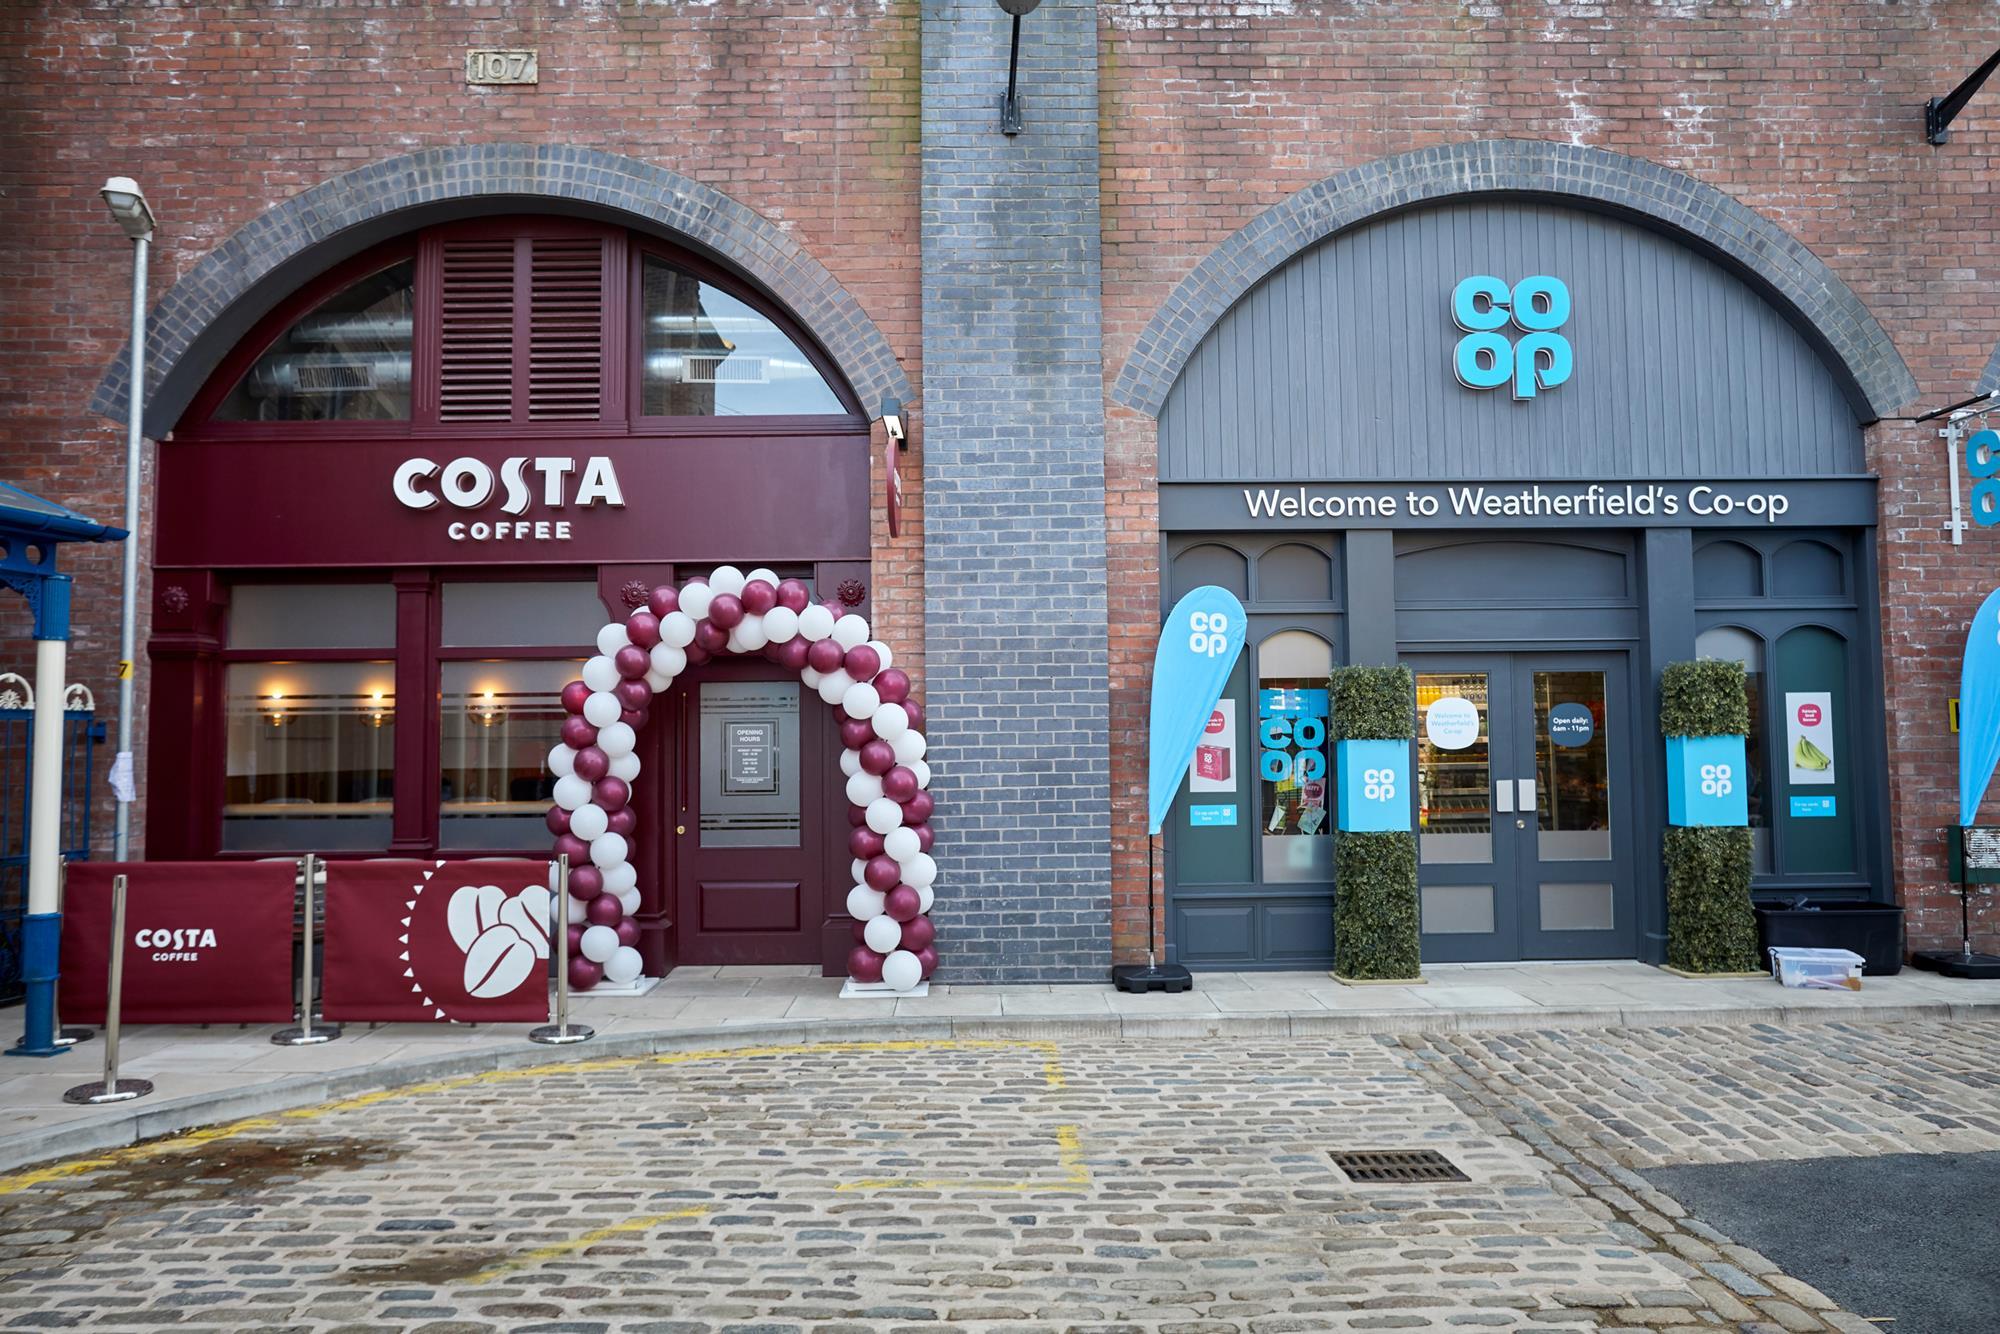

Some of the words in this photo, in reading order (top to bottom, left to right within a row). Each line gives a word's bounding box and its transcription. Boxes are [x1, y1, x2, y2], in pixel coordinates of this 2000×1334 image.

[474, 54, 528, 80] 107
[393, 457, 625, 516] COSTA
[1244, 487, 1397, 518] Welcome
[1406, 491, 1439, 517] to
[1448, 485, 1679, 516] Weatherfield's
[1688, 486, 1789, 523] Co-op
[448, 521, 572, 541] COFFEE
[1553, 717, 1570, 725] Open
[135, 928, 217, 950] COSTA
[152, 953, 198, 961] COFFEE
